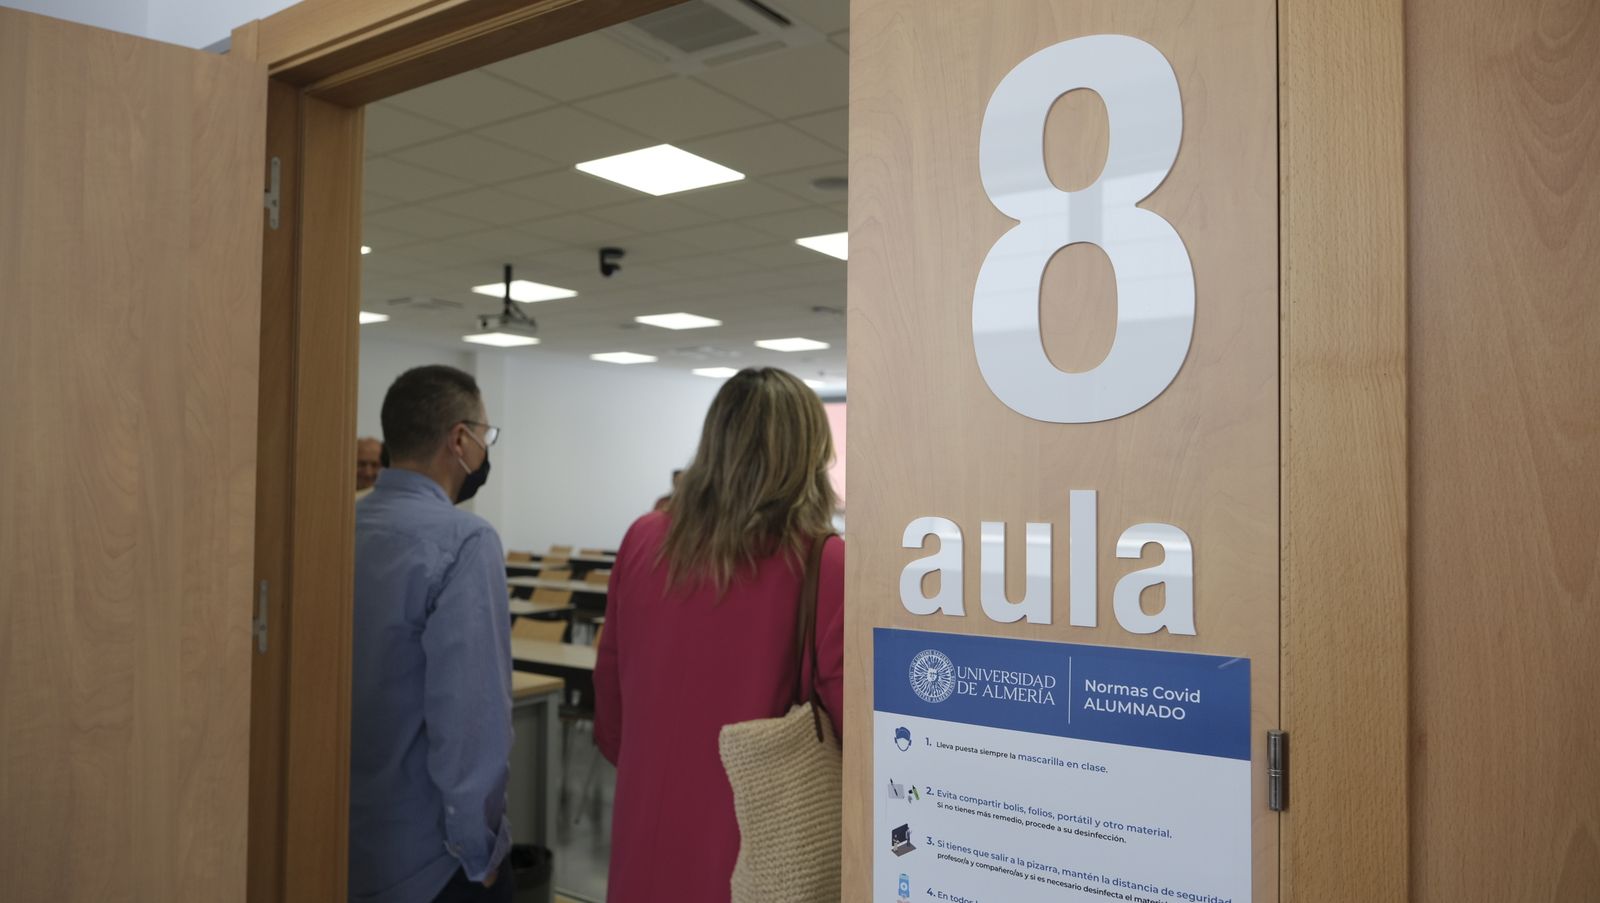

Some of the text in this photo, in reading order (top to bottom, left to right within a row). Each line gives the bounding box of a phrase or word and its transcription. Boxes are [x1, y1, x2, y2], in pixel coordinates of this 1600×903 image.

[972, 34, 1196, 424] 8
[899, 490, 1196, 635] aula
[957, 666, 1056, 689] UNIVERSIDAD
[957, 681, 1056, 706] DE ALMERÍA
[1085, 679, 1201, 704] Normas Covid
[1083, 697, 1186, 720] ALUMNADO
[925, 737, 1109, 774] 1. Lleva puesta siempre la mascarilla en clase.
[926, 786, 1173, 839] 2. Evita compartir bolis, folios, portátil y otro material.
[954, 805, 976, 815] tienes
[977, 810, 992, 819] más
[992, 813, 1024, 826] remedio,
[1025, 820, 1056, 831] procede
[1074, 828, 1127, 844] desinfección.
[926, 836, 935, 846] 3.
[937, 840, 945, 849] Si
[946, 841, 972, 855] tienes
[973, 848, 990, 858] que
[990, 853, 1009, 863] salir
[1017, 857, 1025, 867] la
[1026, 860, 1060, 876] pizarra,
[1062, 868, 1100, 883] mantén
[1102, 875, 1110, 885] la
[1112, 877, 1159, 894] distancia
[1161, 887, 1175, 897] de
[937, 853, 970, 866] profesor/a
[970, 860, 975, 868] y
[1030, 873, 1036, 881] si
[1046, 878, 1082, 891] necesario
[1083, 884, 1124, 900] desinfecta
[926, 887, 936, 897] 4.
[937, 891, 949, 901] En
